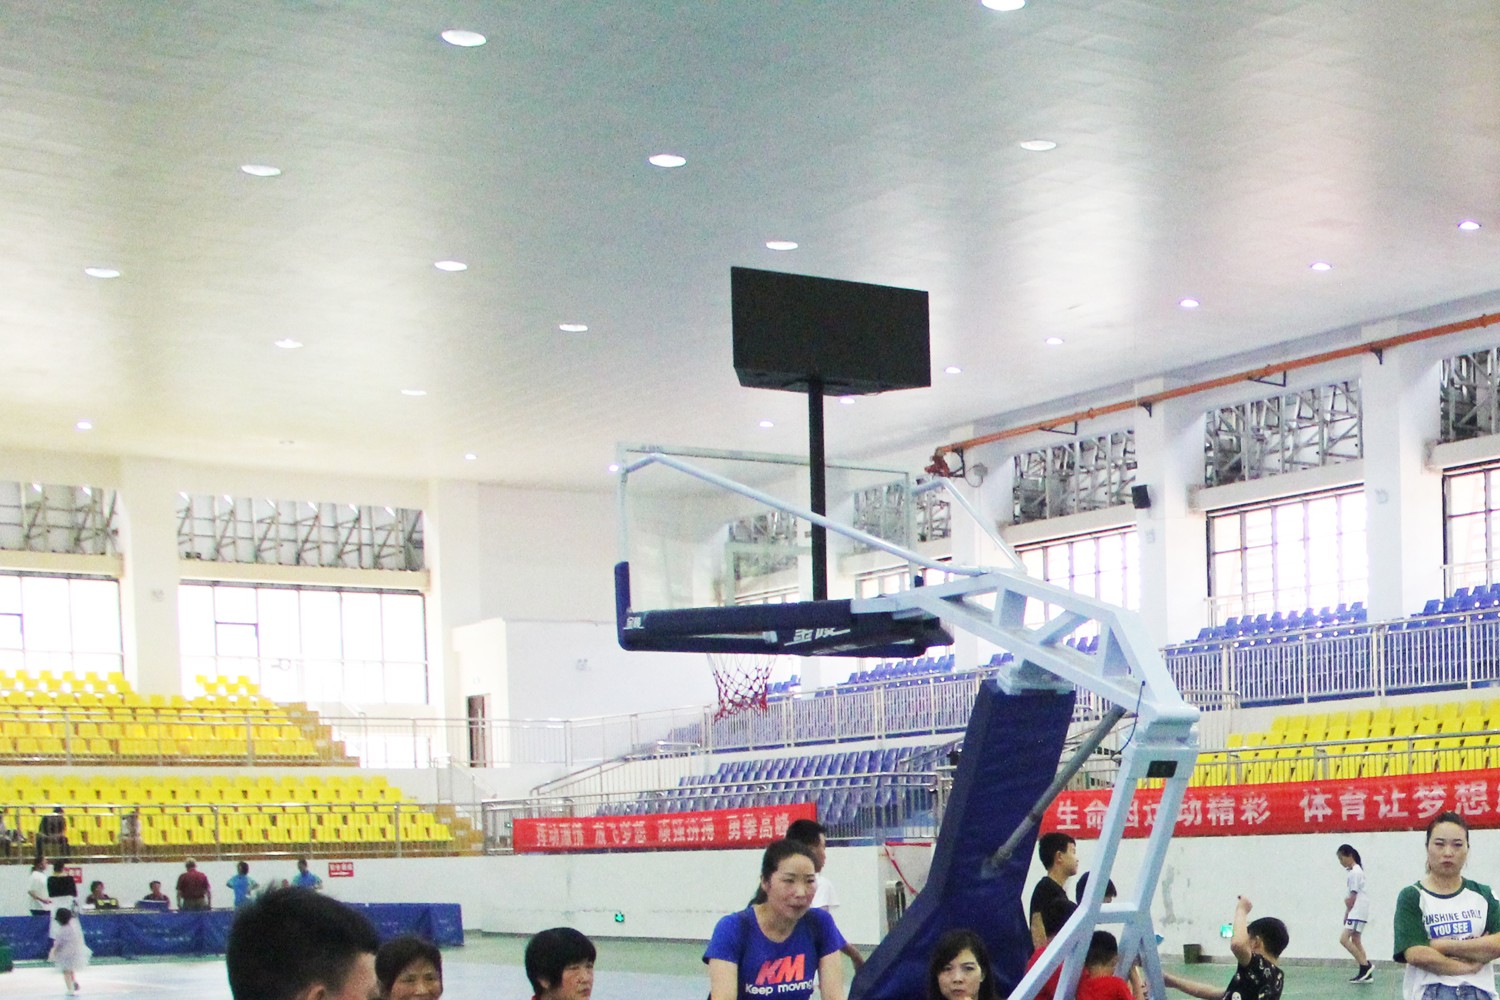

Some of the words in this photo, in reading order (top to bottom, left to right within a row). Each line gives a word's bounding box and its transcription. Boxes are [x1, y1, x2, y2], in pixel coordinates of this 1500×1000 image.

[1433, 923, 1451, 937] YOU
[1452, 922, 1469, 934] SEE
[755, 953, 806, 986] KM
[745, 983, 774, 996] Keep
[777, 979, 813, 993] moving
